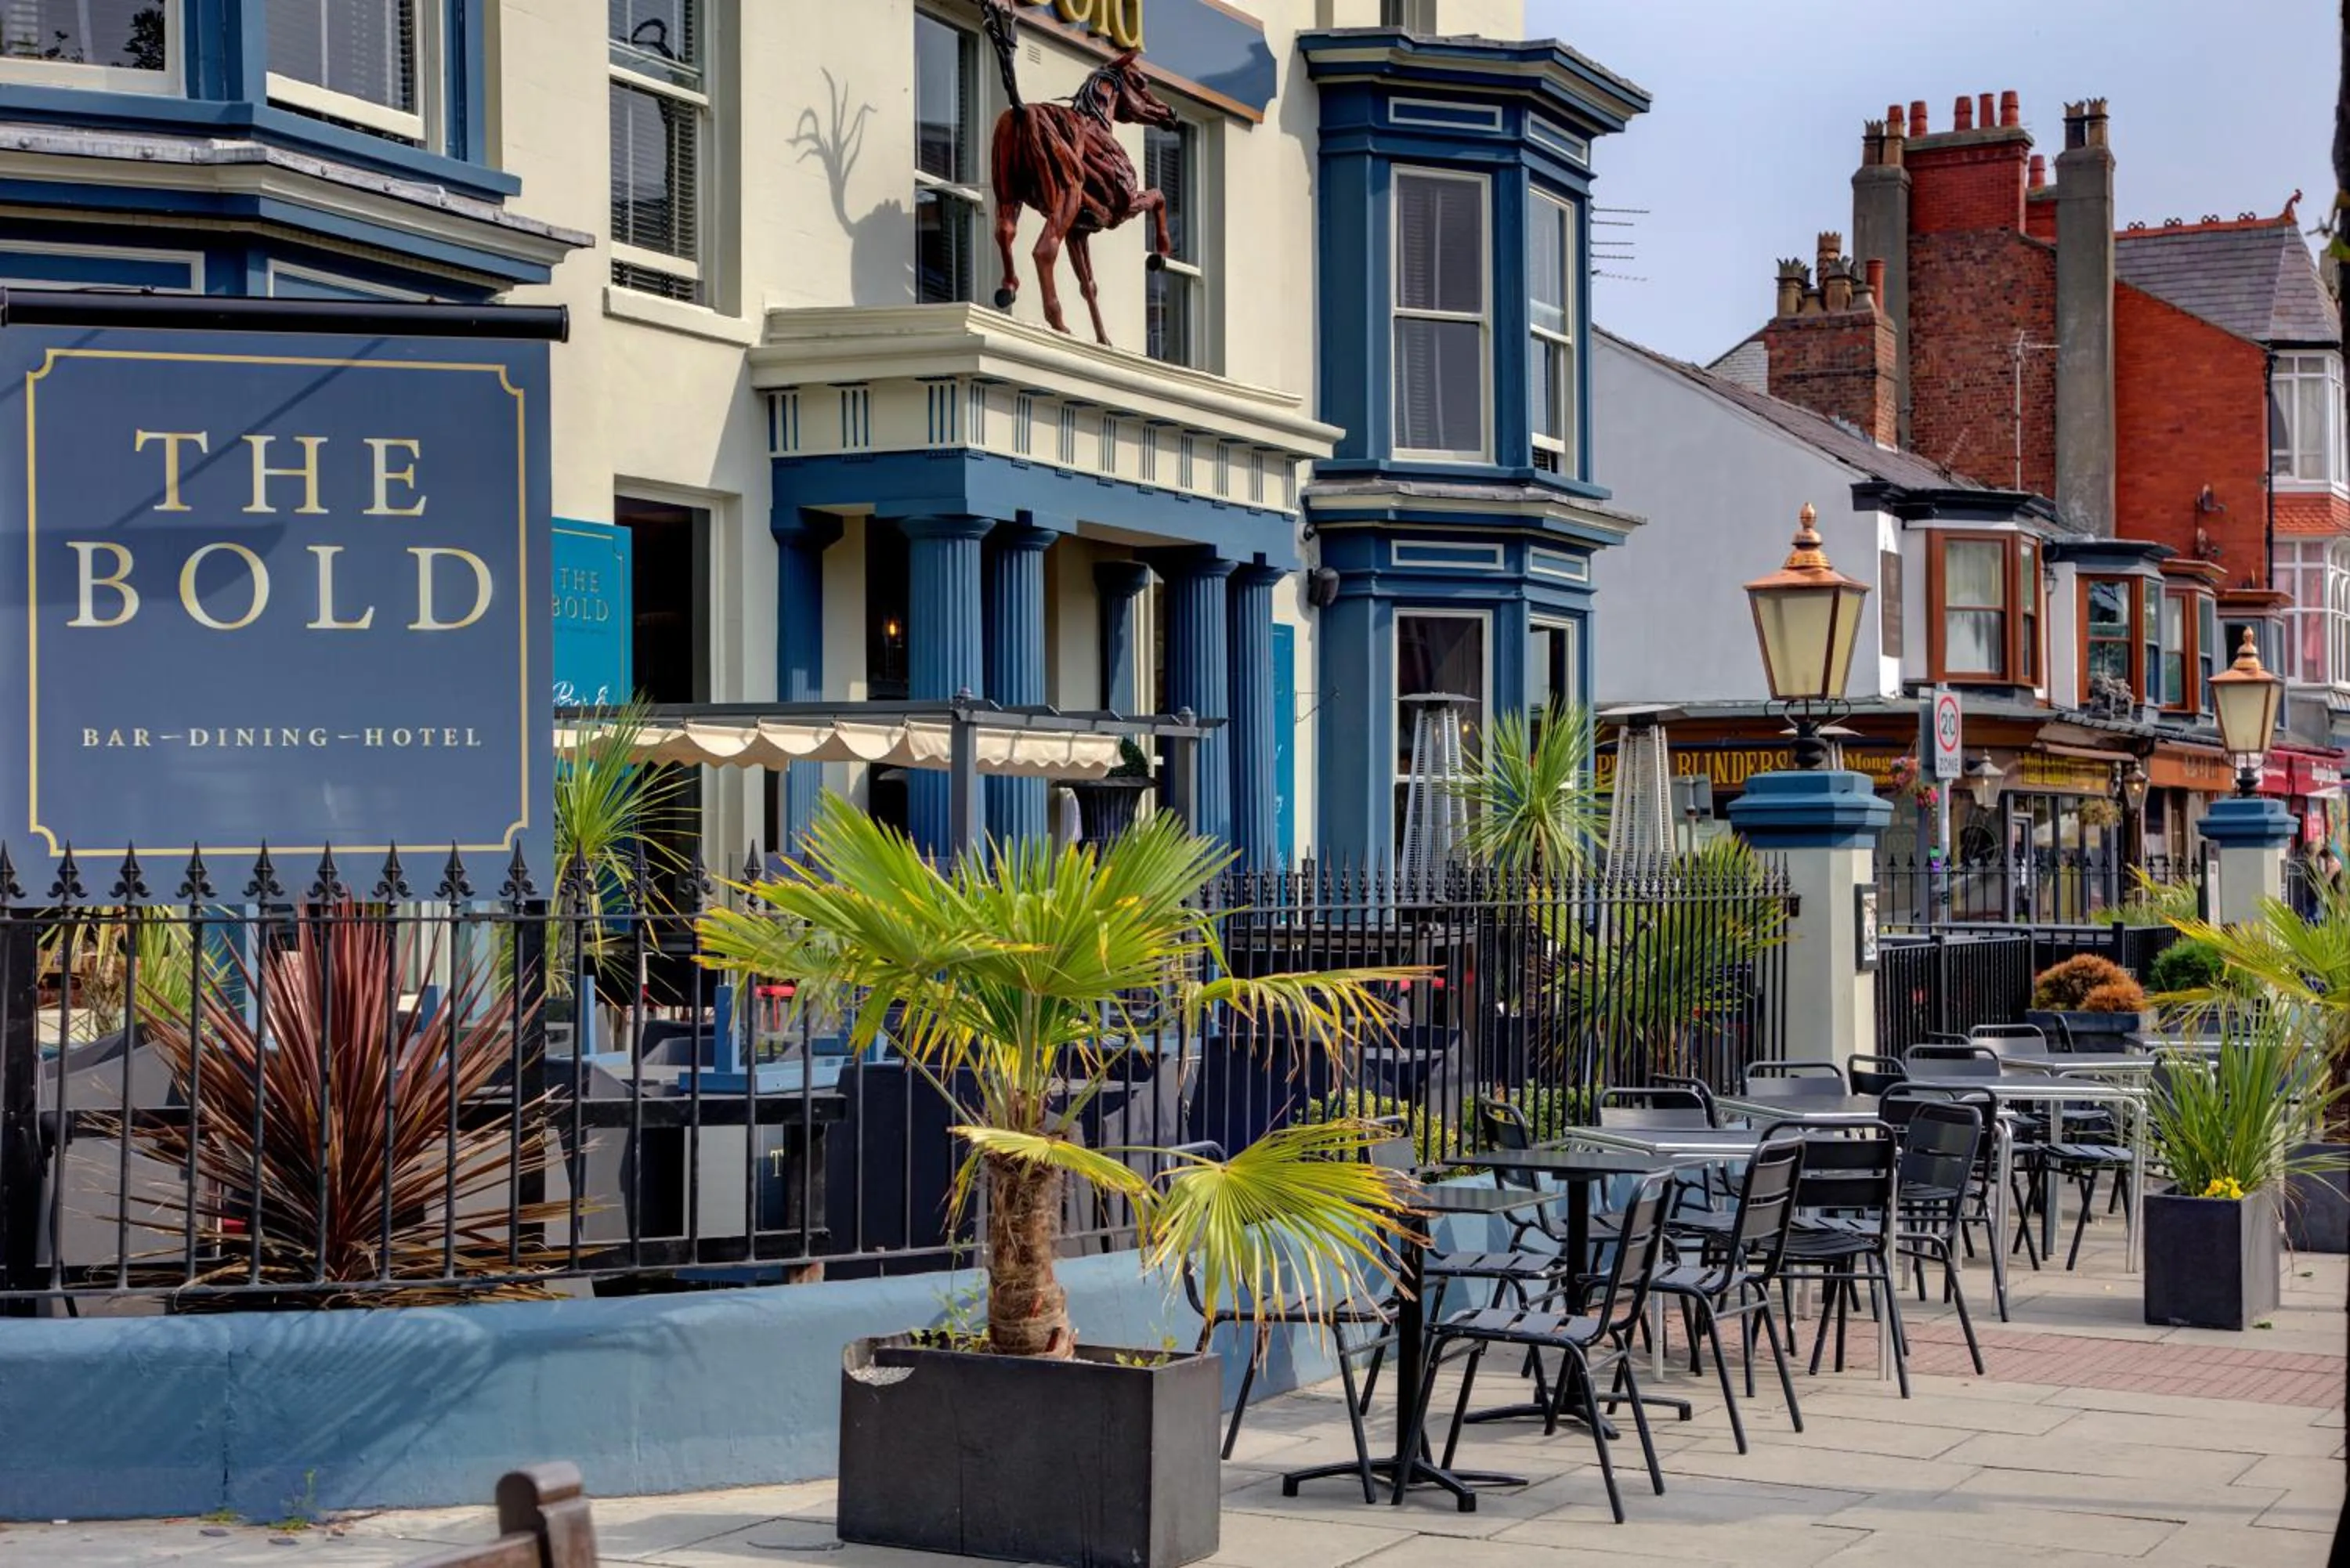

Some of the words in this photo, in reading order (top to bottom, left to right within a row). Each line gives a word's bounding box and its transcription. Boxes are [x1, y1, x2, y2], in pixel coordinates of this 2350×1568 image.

[136, 429, 427, 516] THE
[67, 541, 494, 630] BOLD
[559, 568, 599, 593] THE
[1941, 713, 1956, 736] 20
[1677, 751, 1788, 784] BLINDERS
